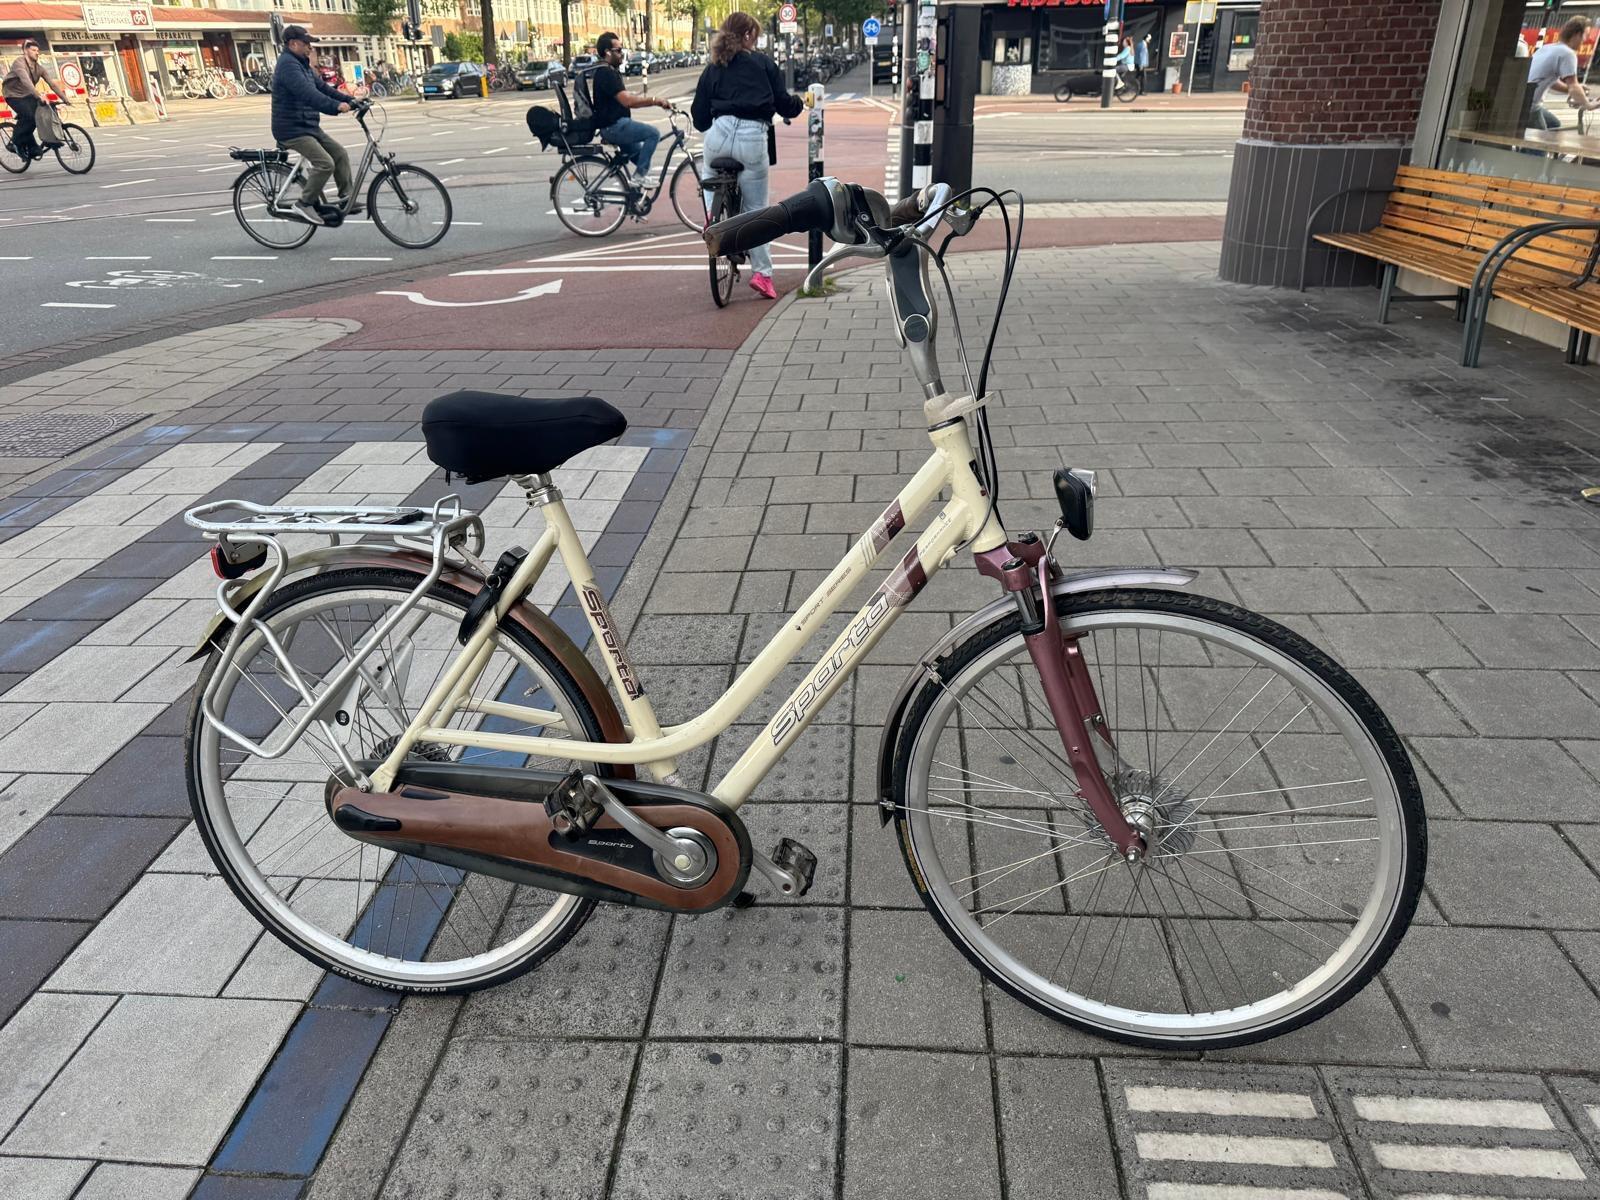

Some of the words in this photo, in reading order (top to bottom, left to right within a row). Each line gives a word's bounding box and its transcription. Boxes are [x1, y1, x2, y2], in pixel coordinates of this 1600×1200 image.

[783, 9, 792, 17] 30
[156, 31, 192, 40] REPARATIE
[801, 596, 825, 626] SPORT
[825, 566, 852, 597] SERIES
[582, 587, 639, 696] Sparta
[771, 593, 889, 745] Sparta
[331, 966, 404, 990] STANDAARD
